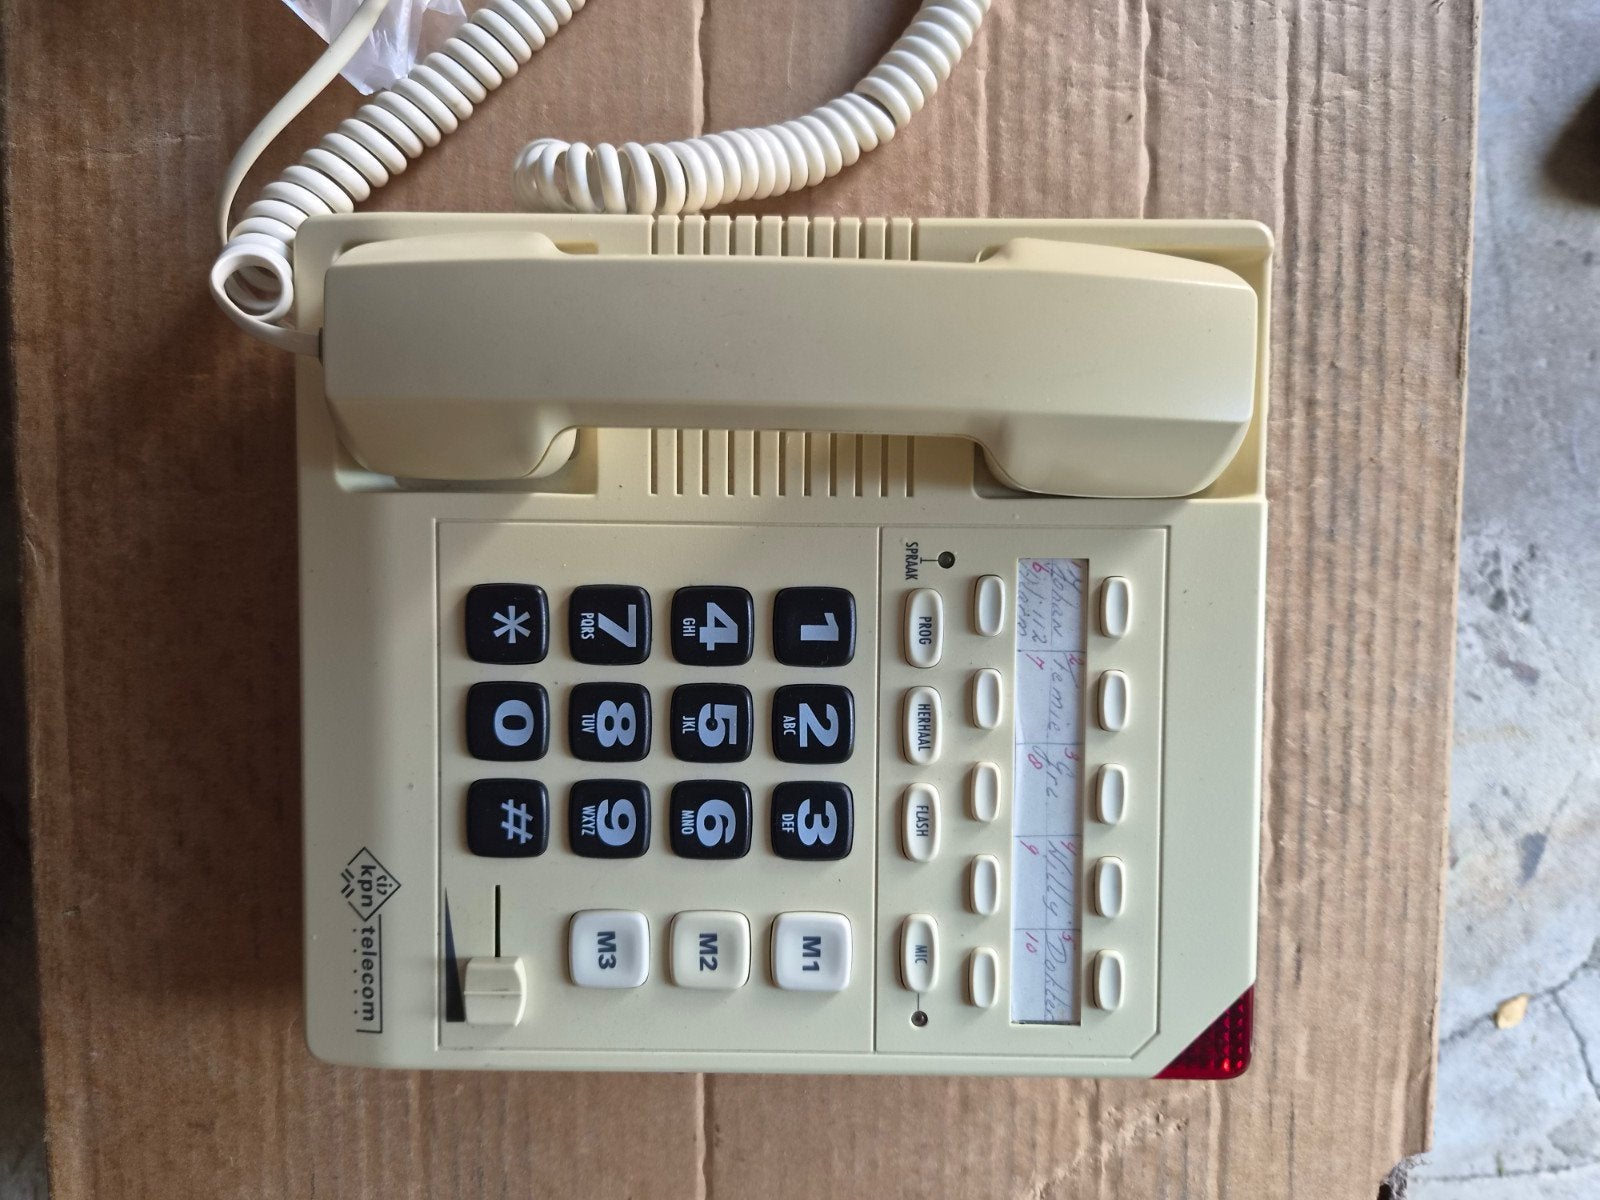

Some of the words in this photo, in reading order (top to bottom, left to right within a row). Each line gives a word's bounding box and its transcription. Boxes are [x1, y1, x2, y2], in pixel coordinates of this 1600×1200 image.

[905, 541, 919, 581] SPRAAK
[580, 612, 595, 640] PQRS
[597, 604, 637, 648] 7
[682, 617, 696, 637] GHI
[699, 602, 739, 651] 4
[799, 612, 840, 642] 1
[918, 616, 932, 645] PROG
[493, 699, 535, 747] 0
[581, 713, 596, 734] TUV
[597, 699, 637, 748] 8
[682, 715, 696, 734] JKL
[698, 702, 738, 748] 5
[783, 715, 797, 736] ABC
[799, 702, 840, 749] 2
[917, 703, 932, 752] HERHAAL
[1027, 753, 1044, 770] 8
[581, 805, 596, 836] WXYZ
[597, 798, 637, 847] 9
[681, 810, 695, 834] MNO
[697, 799, 737, 847] 6
[780, 813, 795, 834] DEF
[797, 799, 838, 846] 3
[915, 805, 930, 837] FLASH
[356, 864, 377, 908] kpn
[597, 931, 618, 970] M3
[699, 932, 719, 972] M2
[801, 935, 822, 973] M1
[914, 944, 928, 965] MIC
[1024, 931, 1040, 955] 10
[361, 926, 378, 1022] telecom
